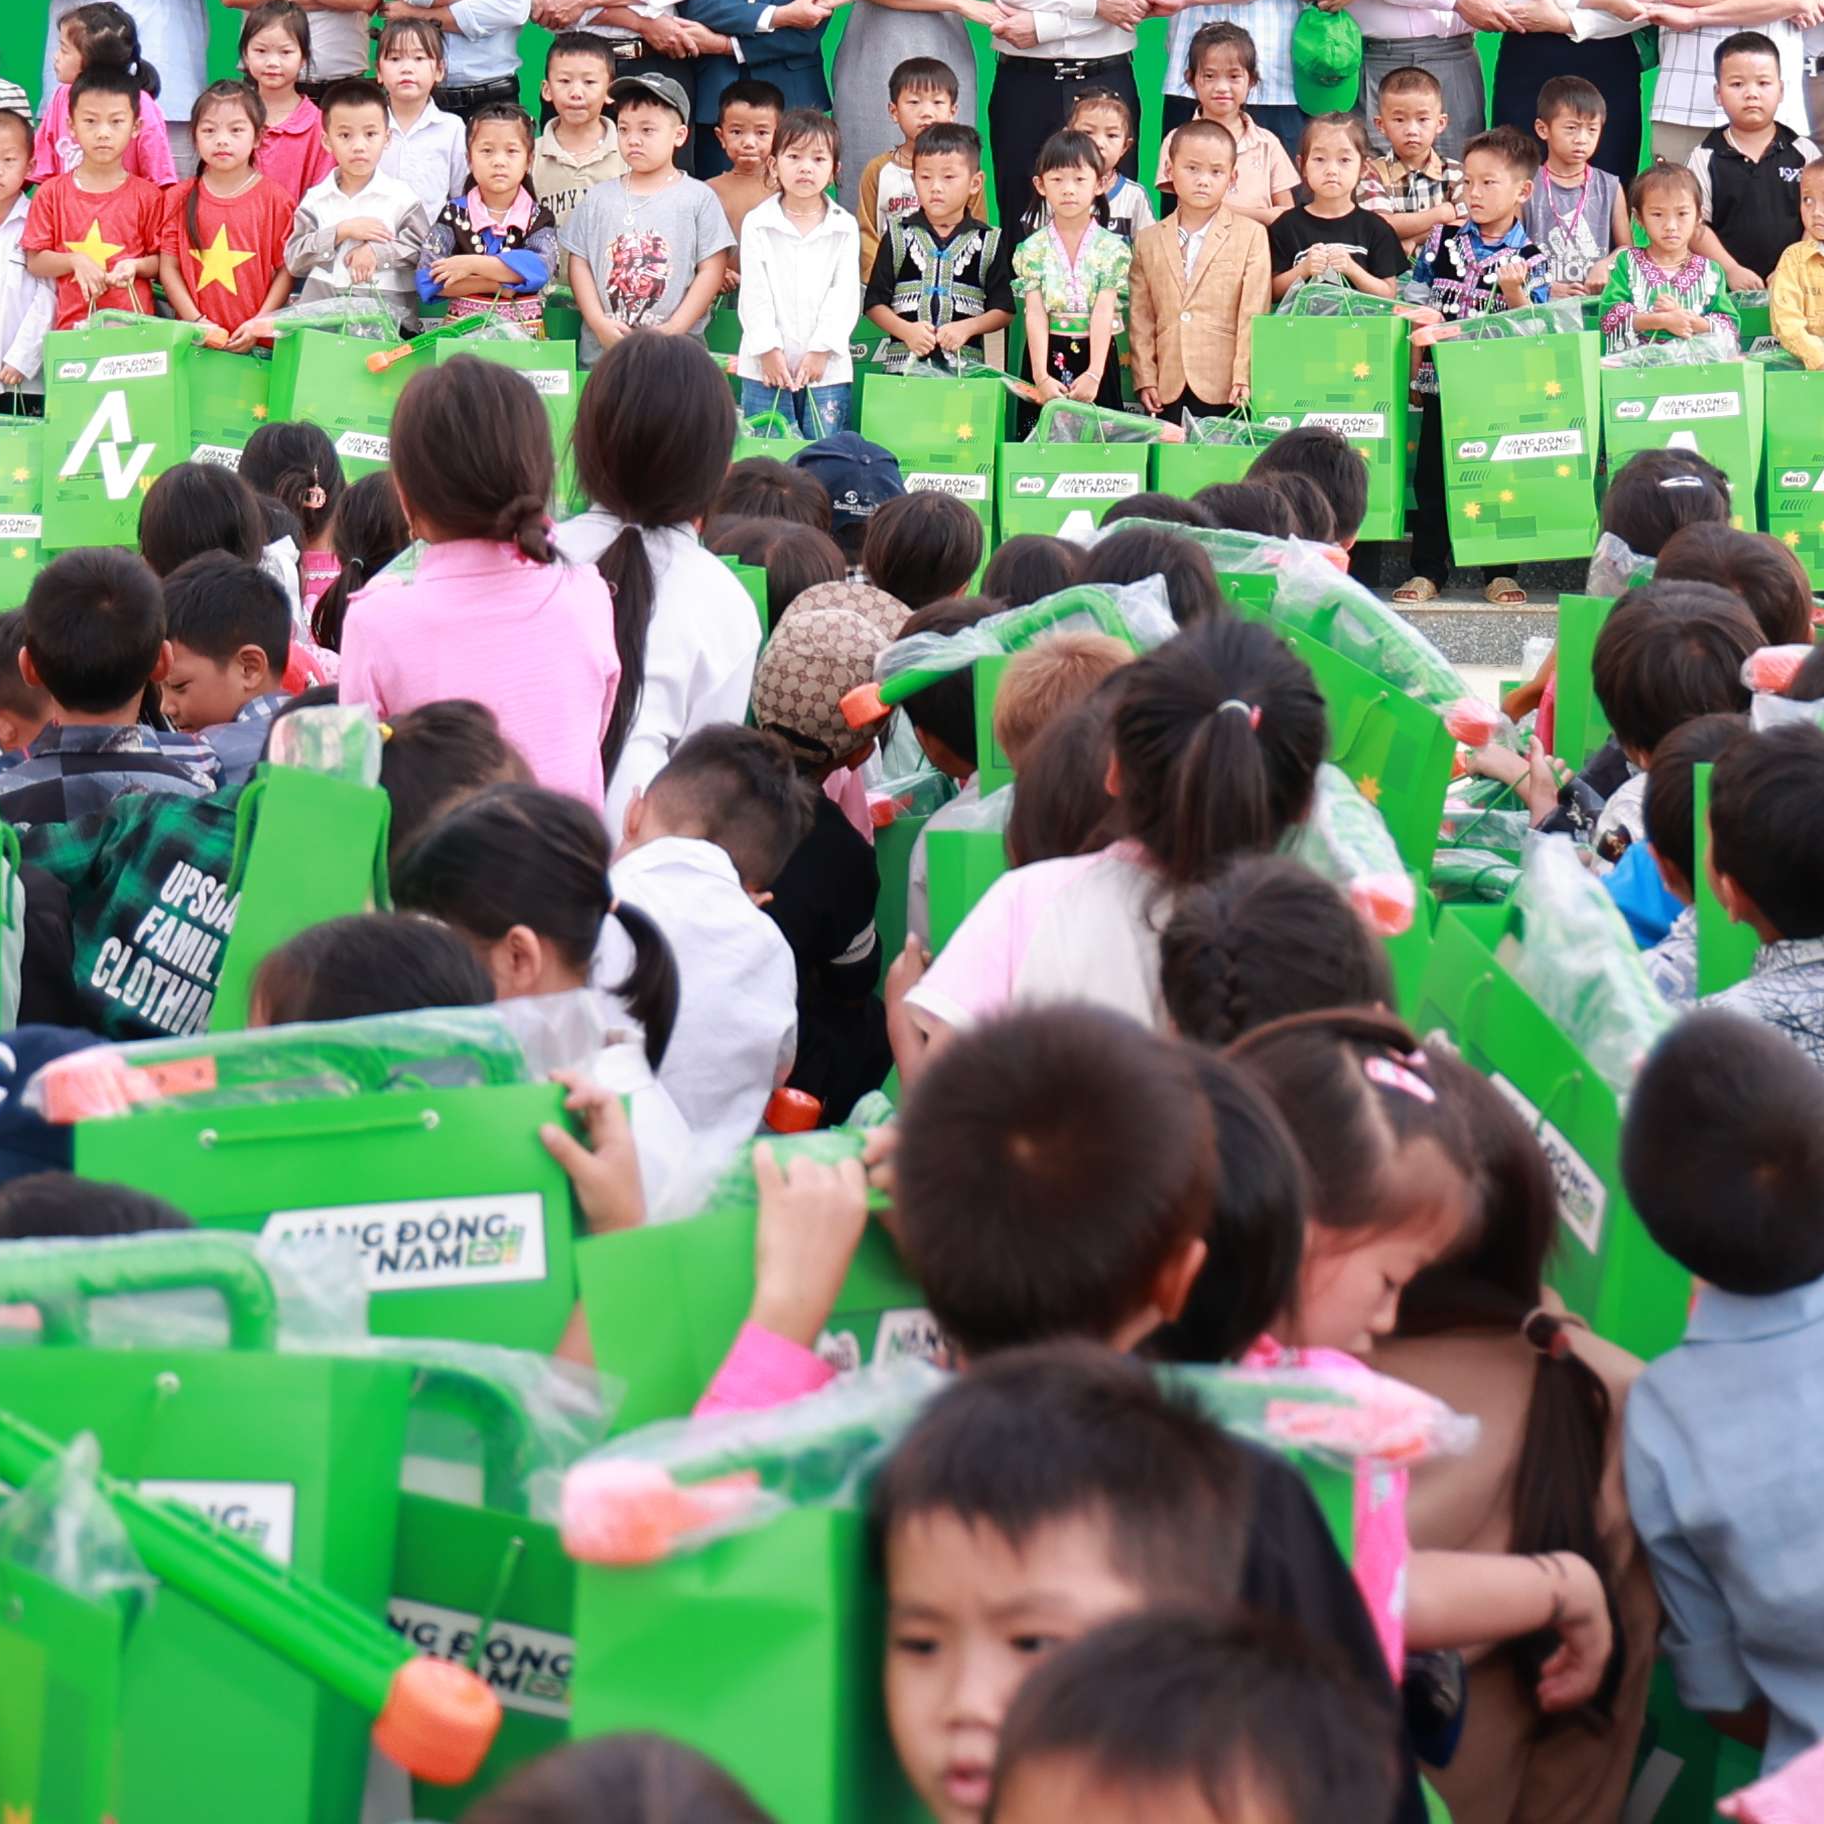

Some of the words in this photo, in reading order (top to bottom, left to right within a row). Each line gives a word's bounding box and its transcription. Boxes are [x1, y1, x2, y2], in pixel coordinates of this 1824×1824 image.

[888, 195, 918, 213] SPIDE
[133, 904, 223, 986] FAMIL
[91, 936, 213, 1038] CLOTHIN
[397, 1211, 506, 1245] ĐỘNG
[376, 1245, 464, 1275] NAM
